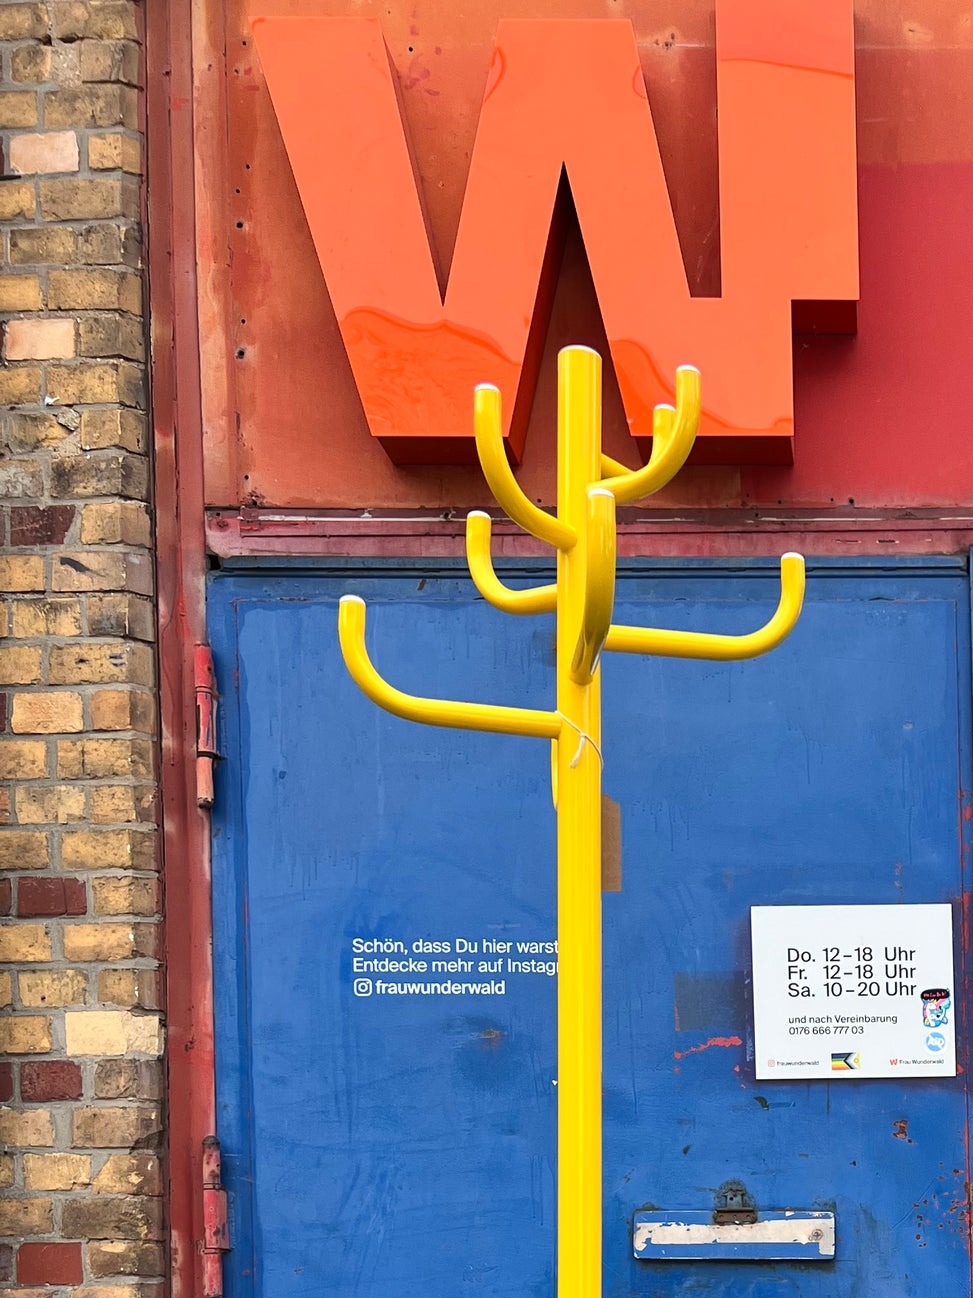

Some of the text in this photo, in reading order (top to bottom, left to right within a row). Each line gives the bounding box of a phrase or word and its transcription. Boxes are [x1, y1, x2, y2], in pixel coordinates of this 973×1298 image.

[352, 938, 409, 955] Schön,
[412, 938, 451, 954] dass
[455, 938, 478, 954] Du
[482, 938, 513, 954] hier
[787, 948, 816, 963] Do.
[884, 946, 916, 962] Uhr
[352, 957, 428, 973] Entdecke
[431, 957, 474, 973] mehr
[477, 957, 505, 973] auf
[787, 965, 808, 980] Fr.
[885, 964, 916, 979] Uhr
[375, 979, 506, 995] frauwunderwald
[787, 982, 816, 998] Sa.
[885, 981, 917, 996] Uhr
[788, 1014, 898, 1025] und nach Vereinbarung
[788, 1025, 864, 1035] 0176 666 777 03
